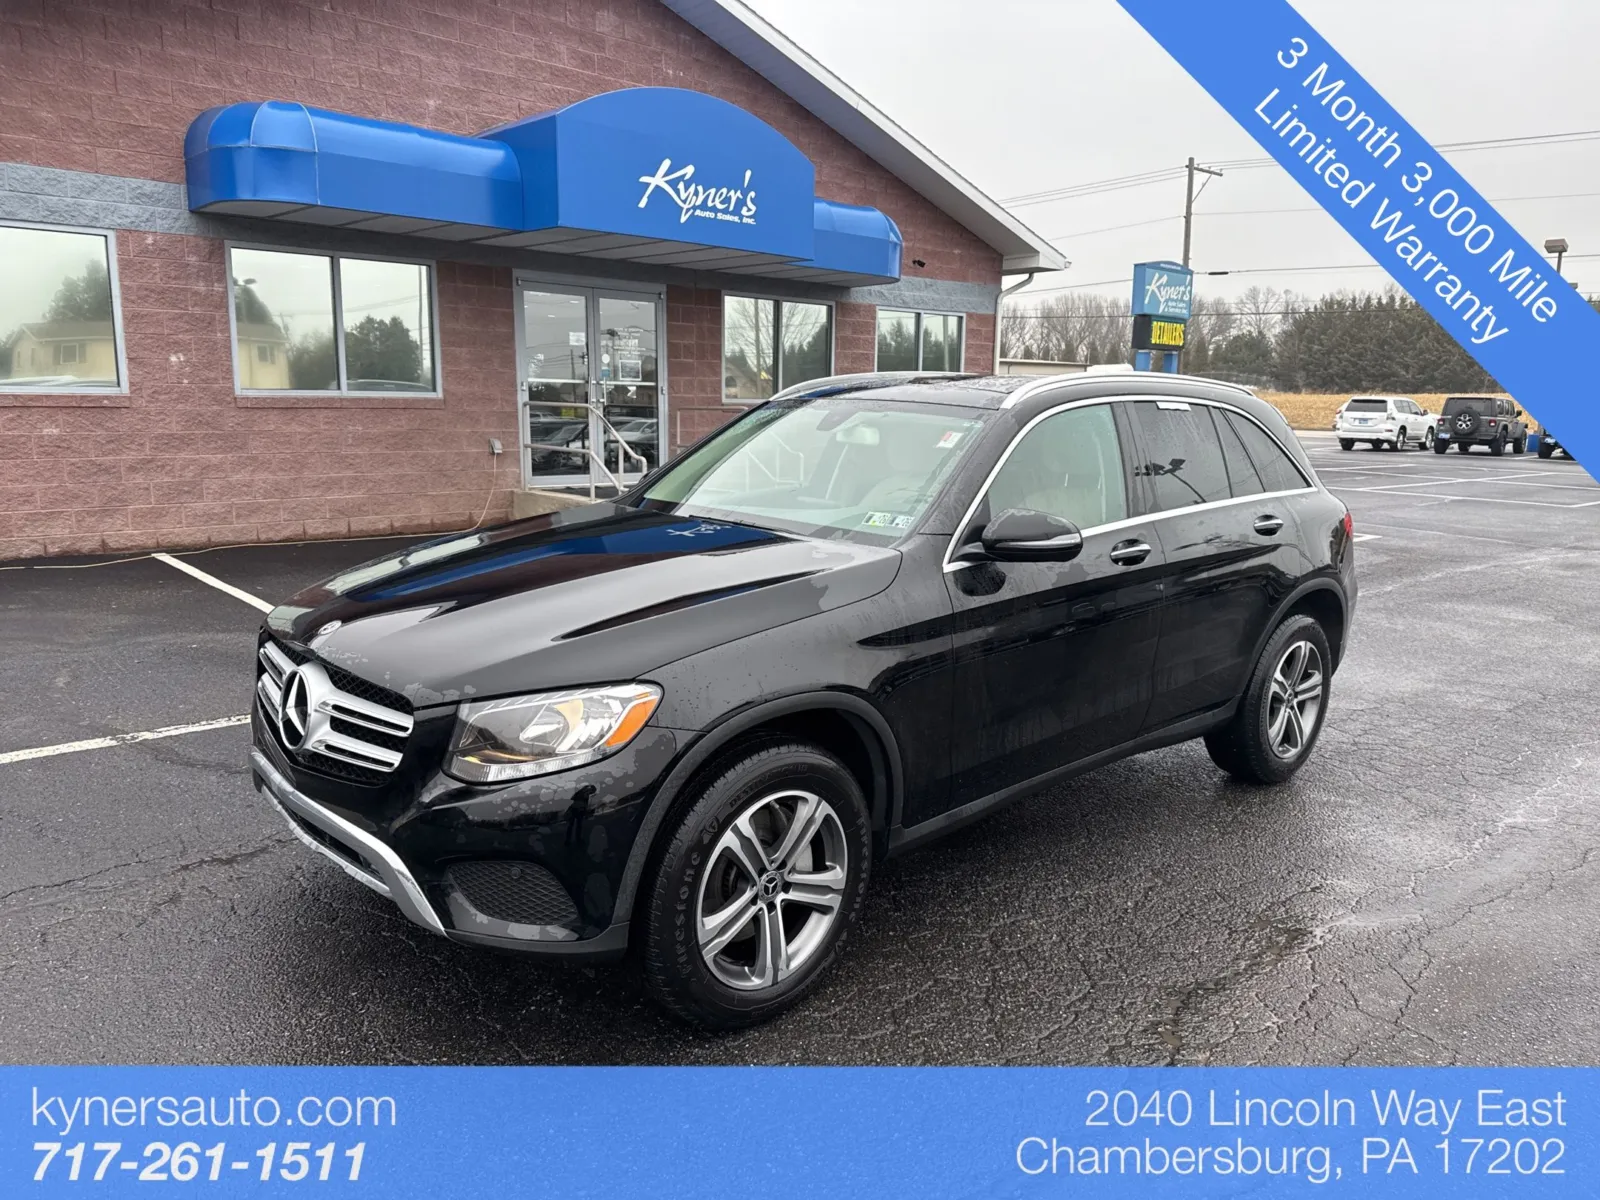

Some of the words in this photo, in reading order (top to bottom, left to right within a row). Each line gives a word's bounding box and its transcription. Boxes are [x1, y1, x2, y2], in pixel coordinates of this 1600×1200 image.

[637, 158, 757, 224] Kyner's
[694, 209, 716, 219] Auto
[742, 216, 757, 225] Inc.
[1144, 272, 1191, 314] Kyner's
[1151, 321, 1185, 346] DETAILERS
